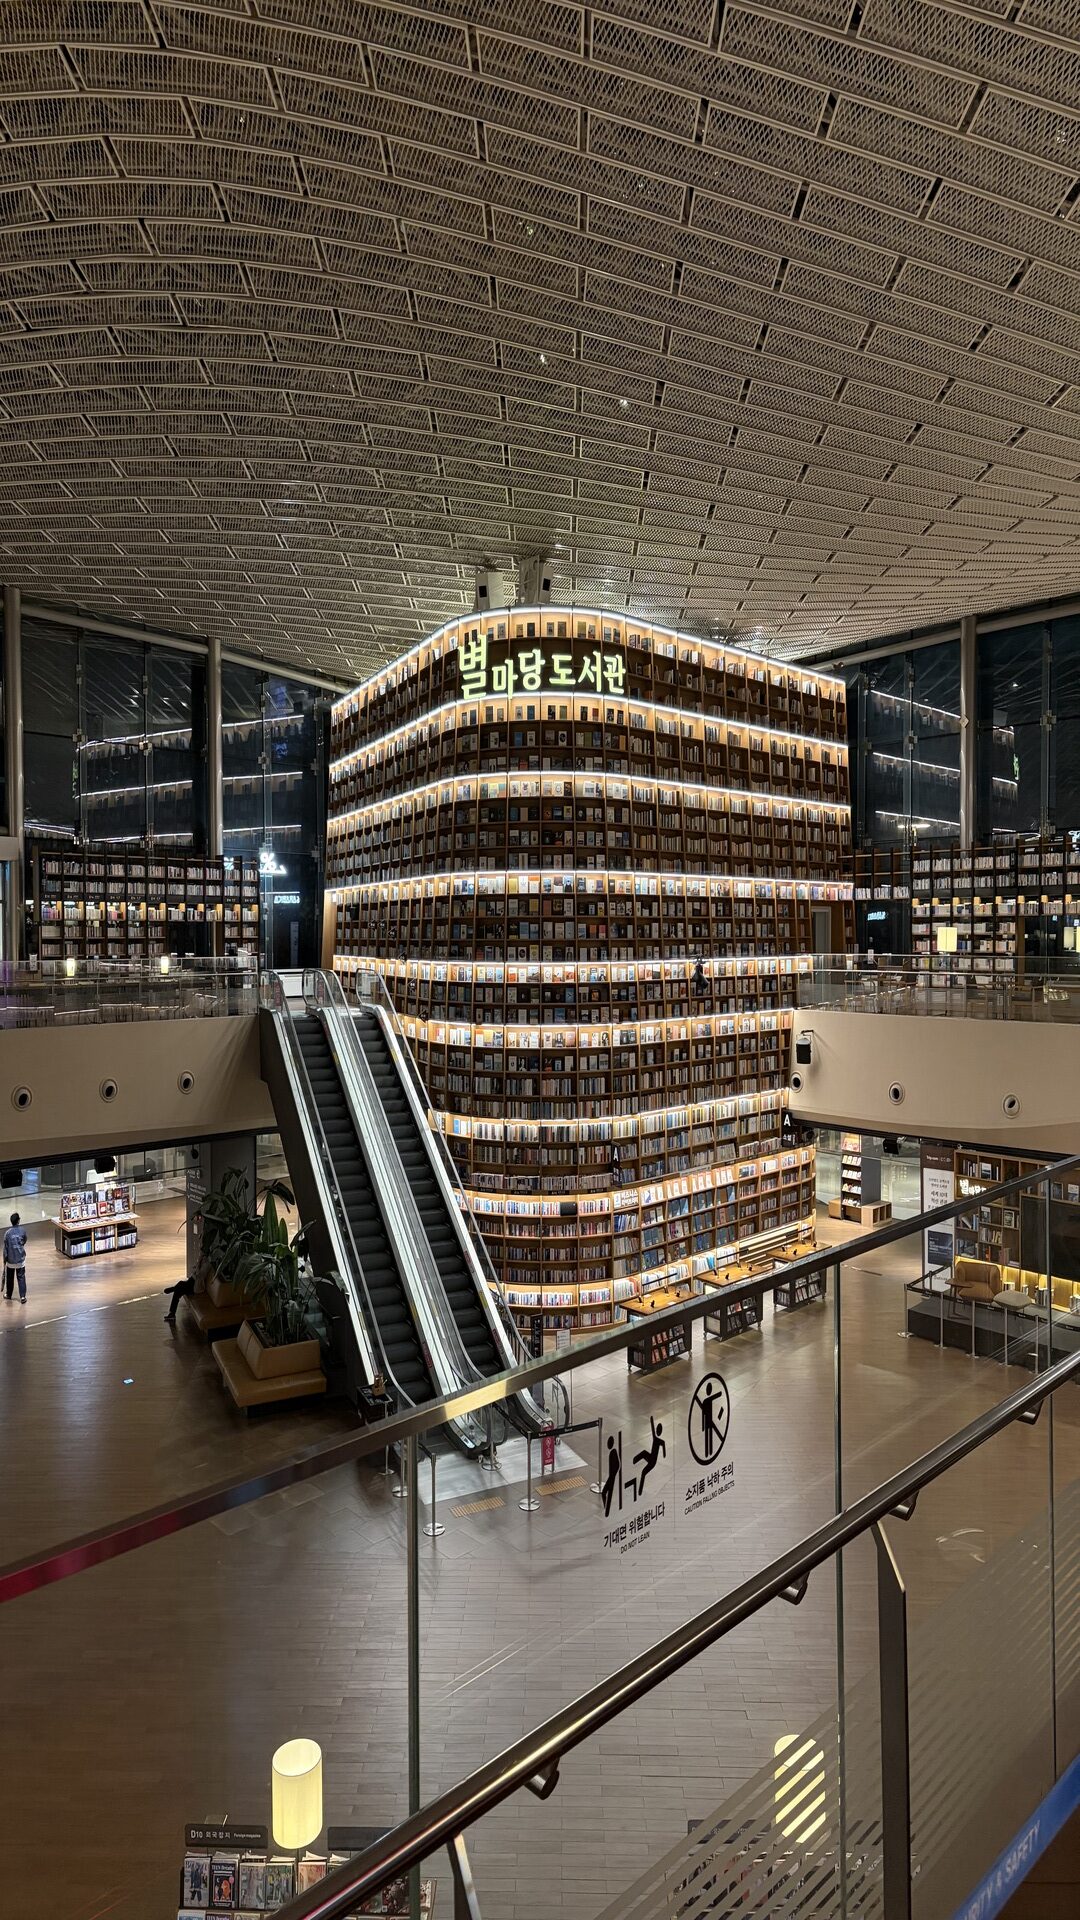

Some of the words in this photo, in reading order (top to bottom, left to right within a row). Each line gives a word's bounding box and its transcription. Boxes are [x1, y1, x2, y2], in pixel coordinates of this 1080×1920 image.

[783, 1113, 791, 1127] A
[684, 1499, 703, 1515] CAUTION
[703, 1490, 718, 1504] FALLING
[718, 1480, 735, 1495] OBJECTS
[685, 1478, 706, 1501] 소지품
[707, 1469, 720, 1487] 낙하
[721, 1461, 734, 1480] 주의
[603, 1523, 627, 1548] 기대면
[629, 1501, 666, 1534] 위험합니다
[620, 1545, 628, 1554] DO
[628, 1538, 637, 1549] NOT
[638, 1531, 650, 1544] LEAN
